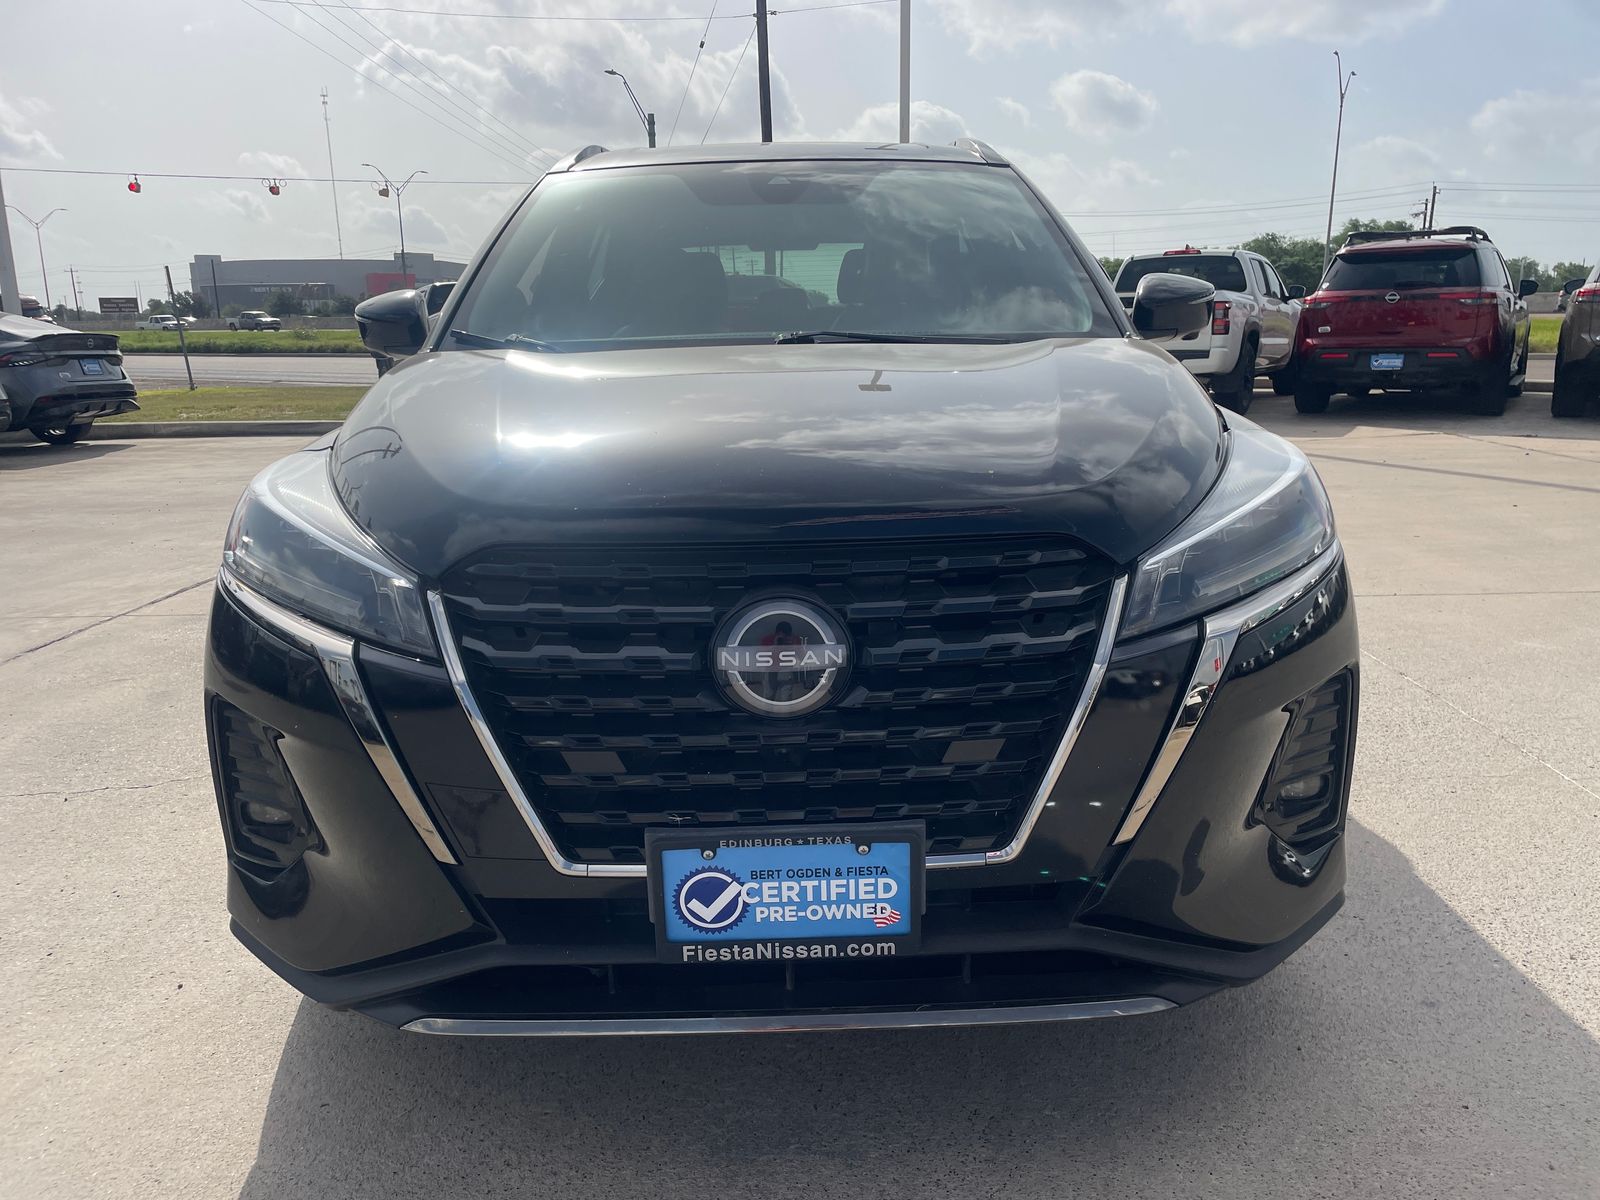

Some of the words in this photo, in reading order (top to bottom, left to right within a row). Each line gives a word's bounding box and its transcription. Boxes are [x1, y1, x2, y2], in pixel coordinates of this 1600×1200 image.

[721, 649, 843, 667] NISSAN
[720, 838, 793, 849] EDINBURG
[807, 836, 852, 846] TEXAS
[750, 869, 782, 880] BERT
[786, 867, 831, 879] OGDEN
[834, 867, 843, 877] &
[846, 866, 889, 876] FIESTA
[741, 877, 898, 904] CERTIFIED
[755, 902, 892, 923] PRE-OWNED
[682, 941, 896, 962] FiestaNissan.com
